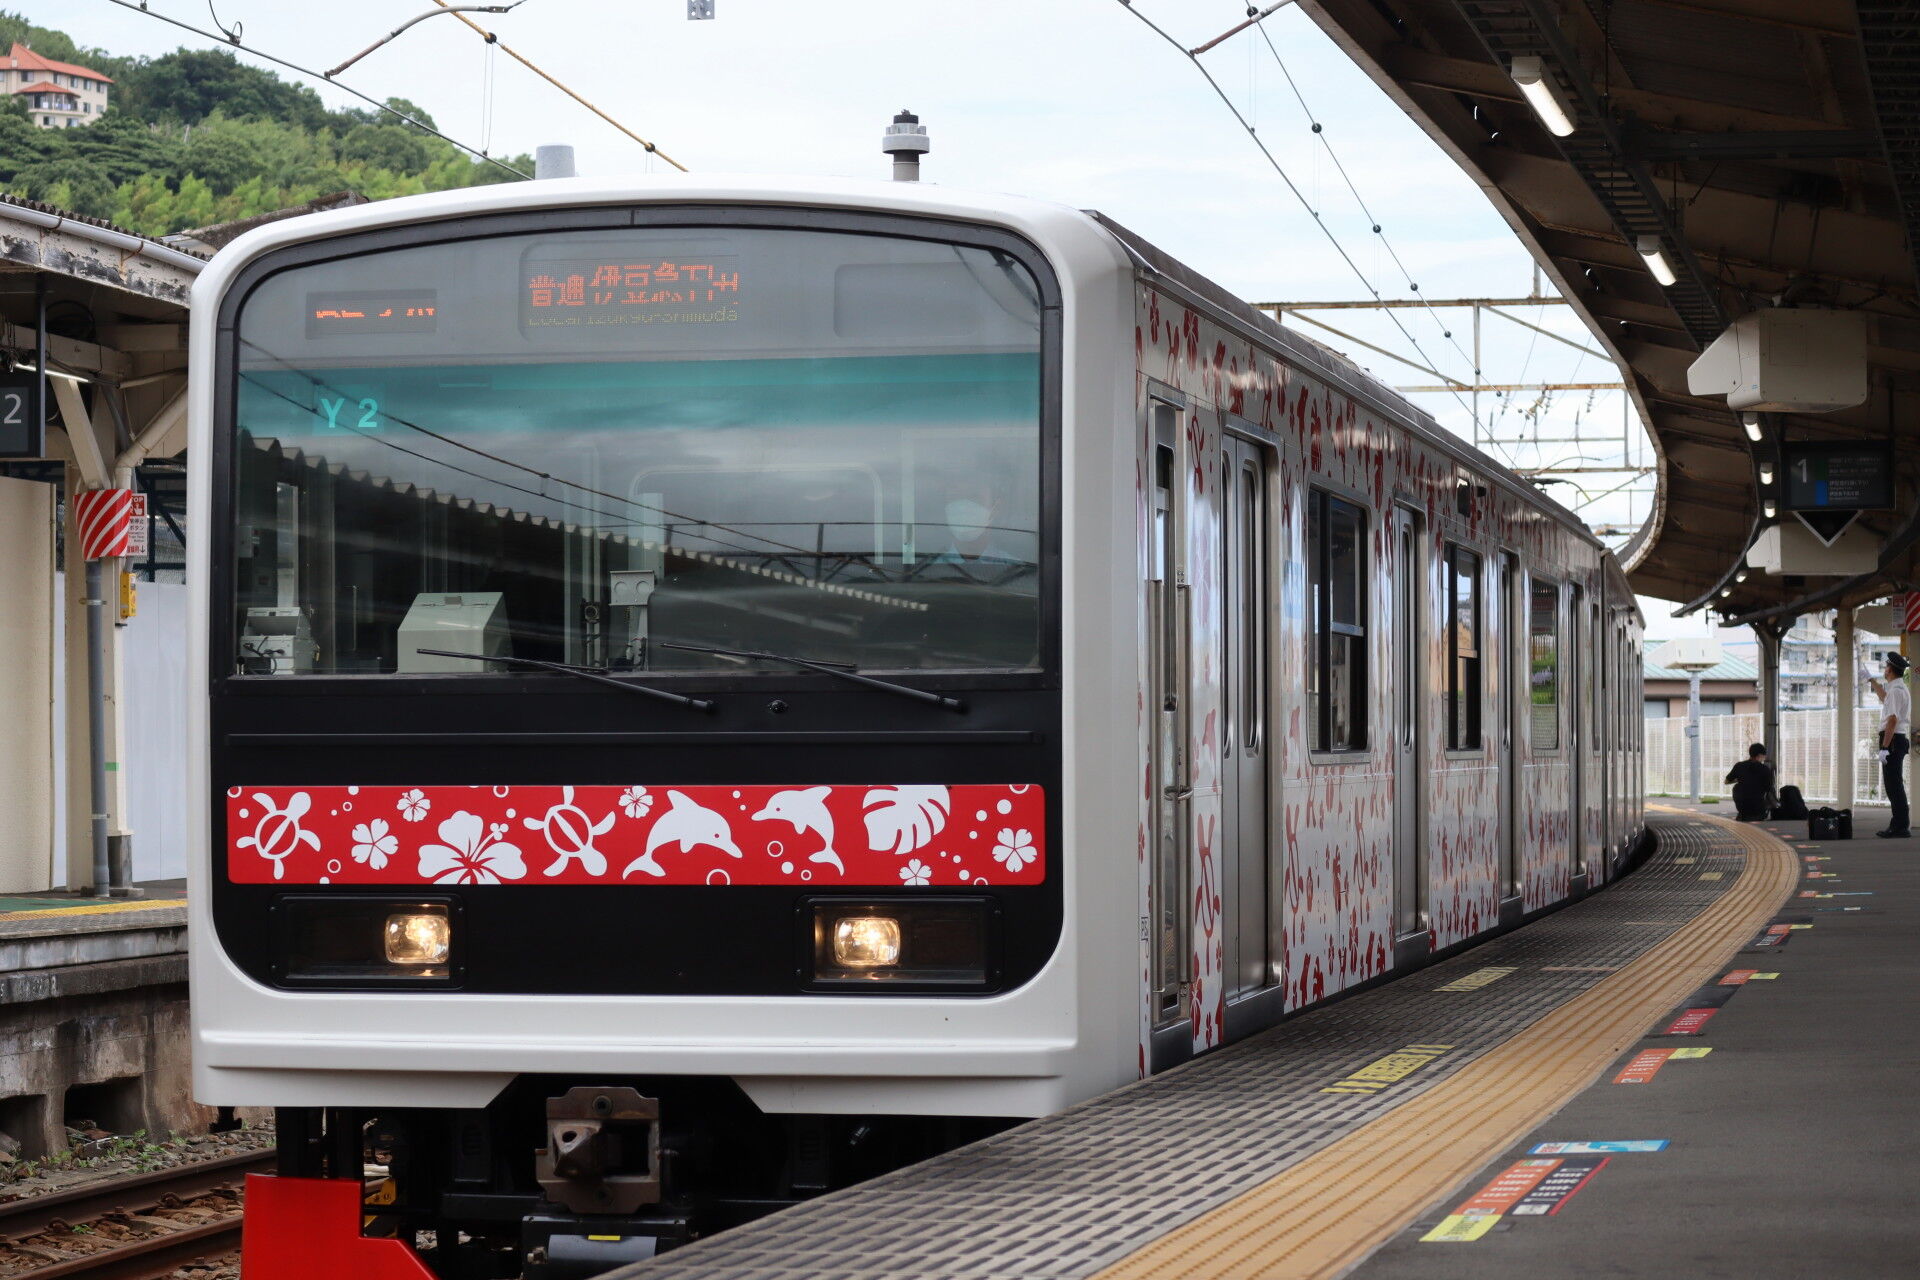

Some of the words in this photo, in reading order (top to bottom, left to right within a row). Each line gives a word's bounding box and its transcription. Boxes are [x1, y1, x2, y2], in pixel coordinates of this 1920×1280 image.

[528, 274, 585, 307] 普通
[4, 393, 22, 424] 2
[320, 398, 346, 428] Y
[358, 398, 379, 428] 2
[1796, 458, 1808, 484] 1
